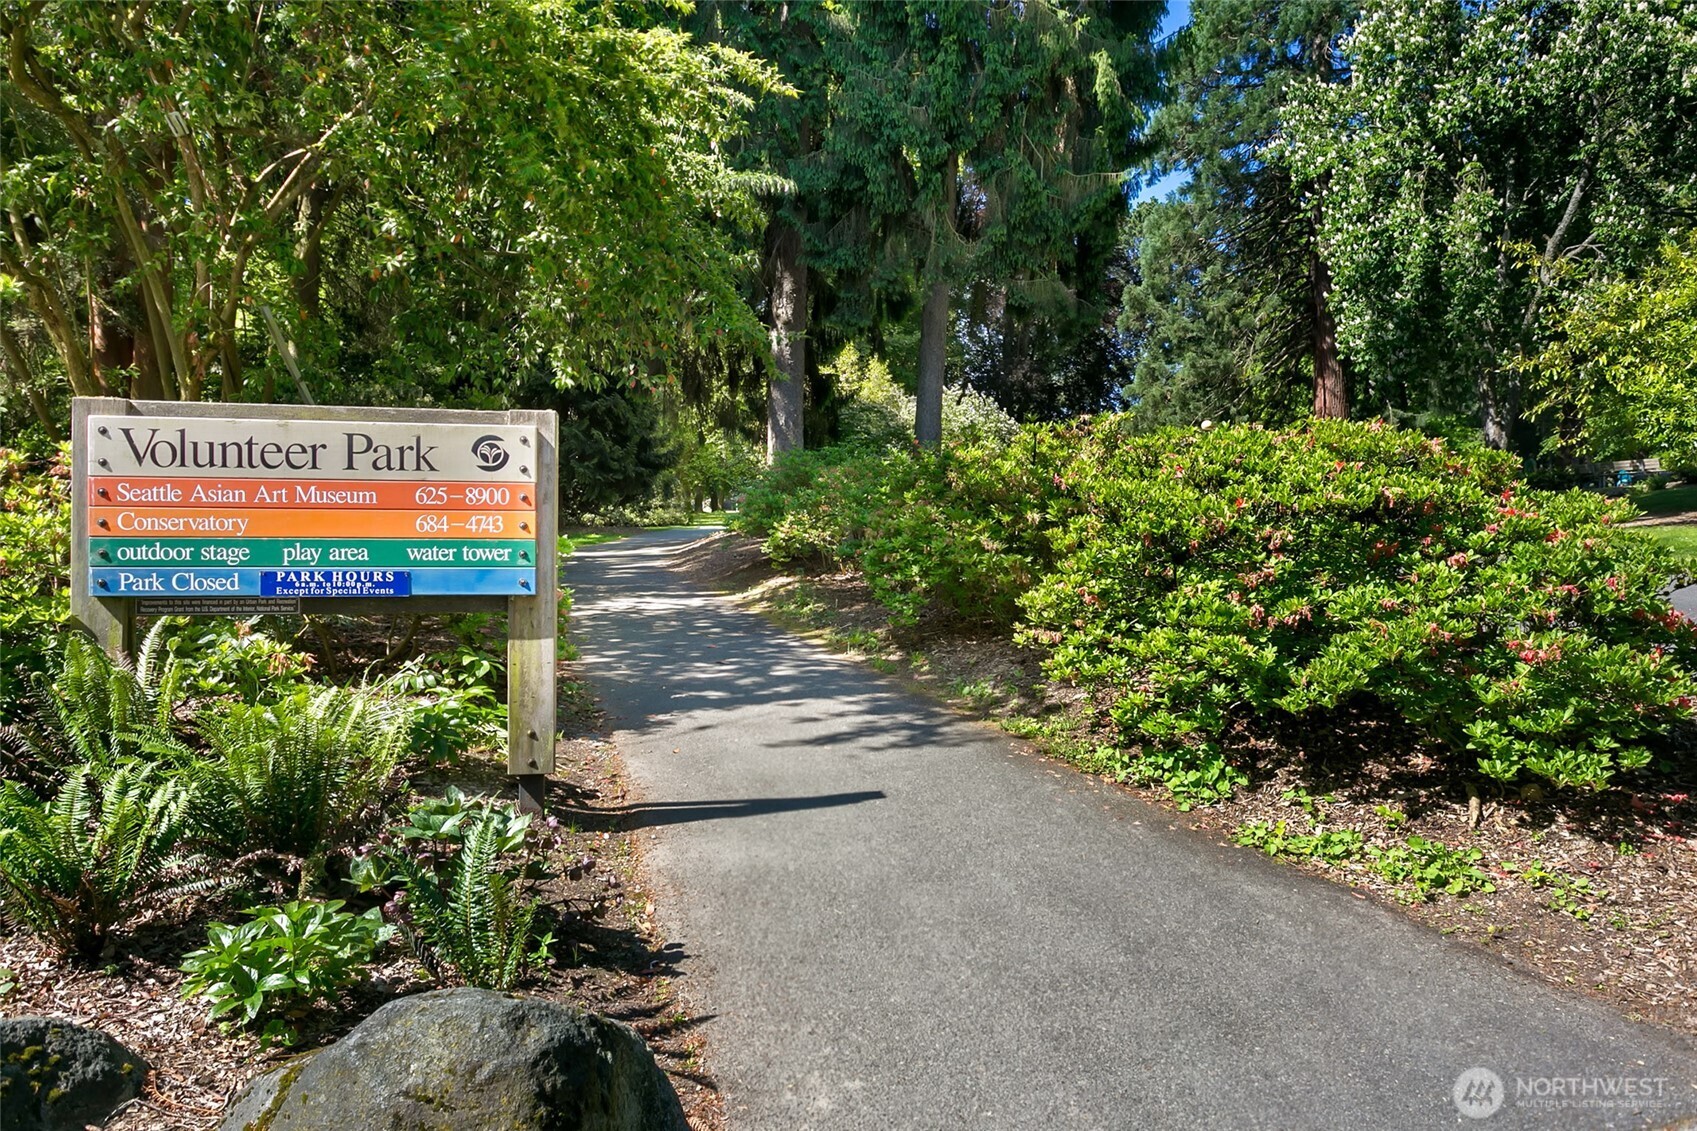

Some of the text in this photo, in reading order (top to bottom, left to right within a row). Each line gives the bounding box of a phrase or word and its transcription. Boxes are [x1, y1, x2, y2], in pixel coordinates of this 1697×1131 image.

[119, 427, 440, 472] Volunteer Park
[116, 482, 377, 504] Seattle Asian Art Museum
[116, 511, 249, 536] Conservatory
[116, 542, 250, 566] outdoor stage
[282, 542, 369, 566] play area
[406, 545, 512, 562] water tower
[118, 572, 240, 591] Park Closed
[276, 571, 394, 582] PARK HOURS
[276, 586, 394, 597] Except for Special Events
